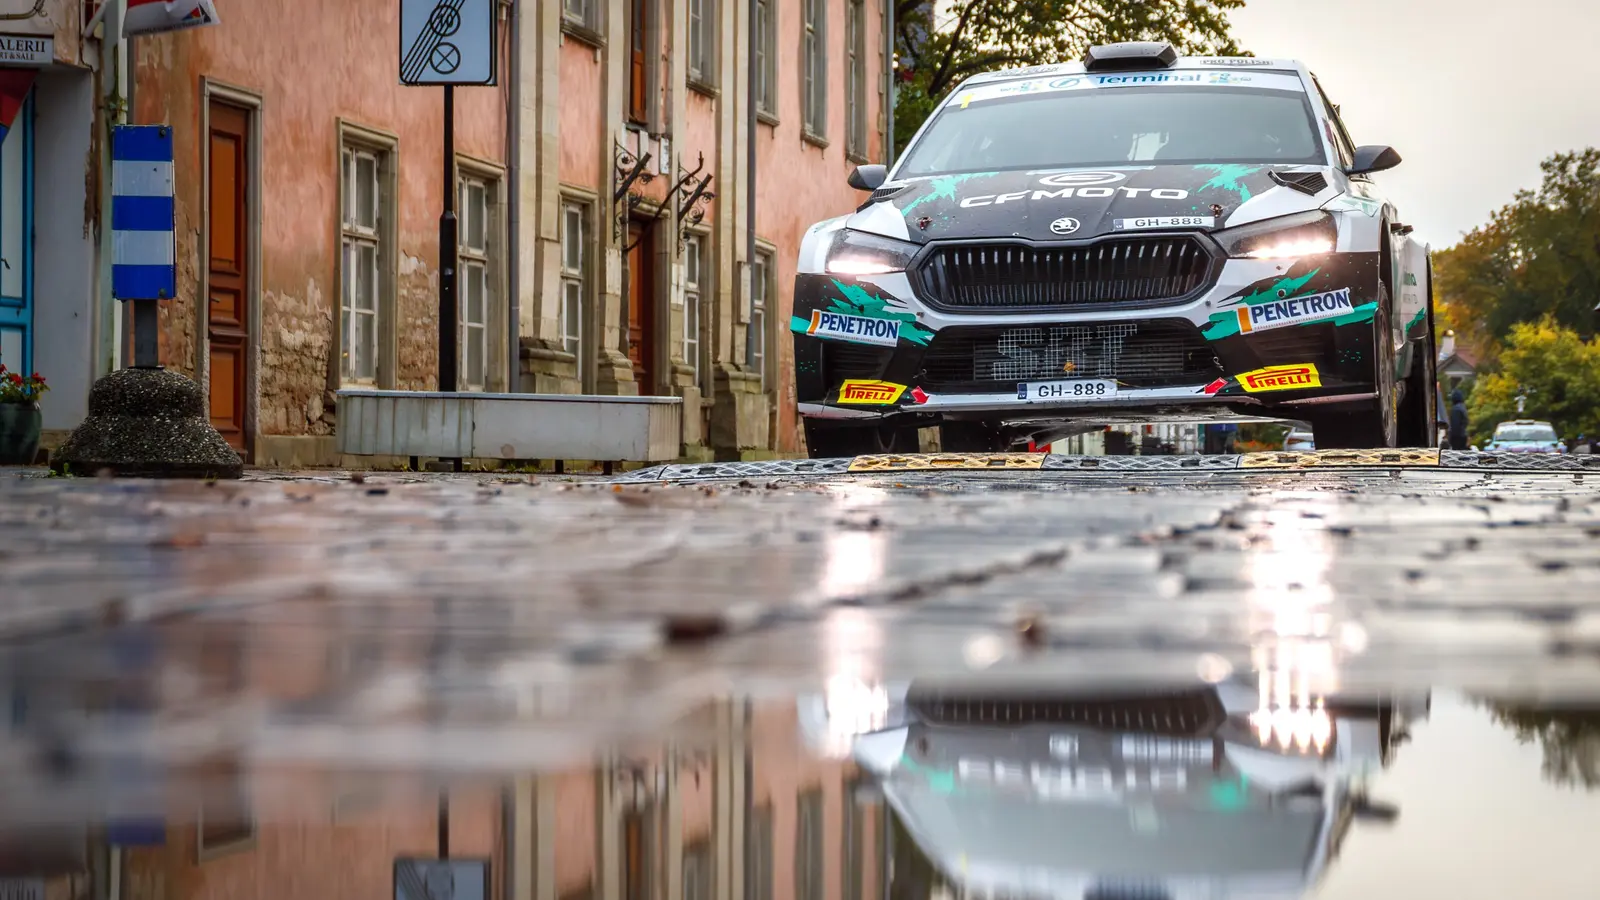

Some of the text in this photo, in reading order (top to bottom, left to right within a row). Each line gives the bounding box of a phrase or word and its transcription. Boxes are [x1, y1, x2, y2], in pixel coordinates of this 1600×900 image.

[1097, 73, 1201, 84] Terminal
[960, 187, 1189, 208] CFMOTO
[1135, 217, 1203, 227] GH-888
[1250, 289, 1351, 324] PENETRON
[819, 313, 899, 339] PENETRON
[1245, 368, 1311, 389] PIRELLI
[844, 383, 897, 401] PIRELLI
[1038, 382, 1106, 397] GH-888
